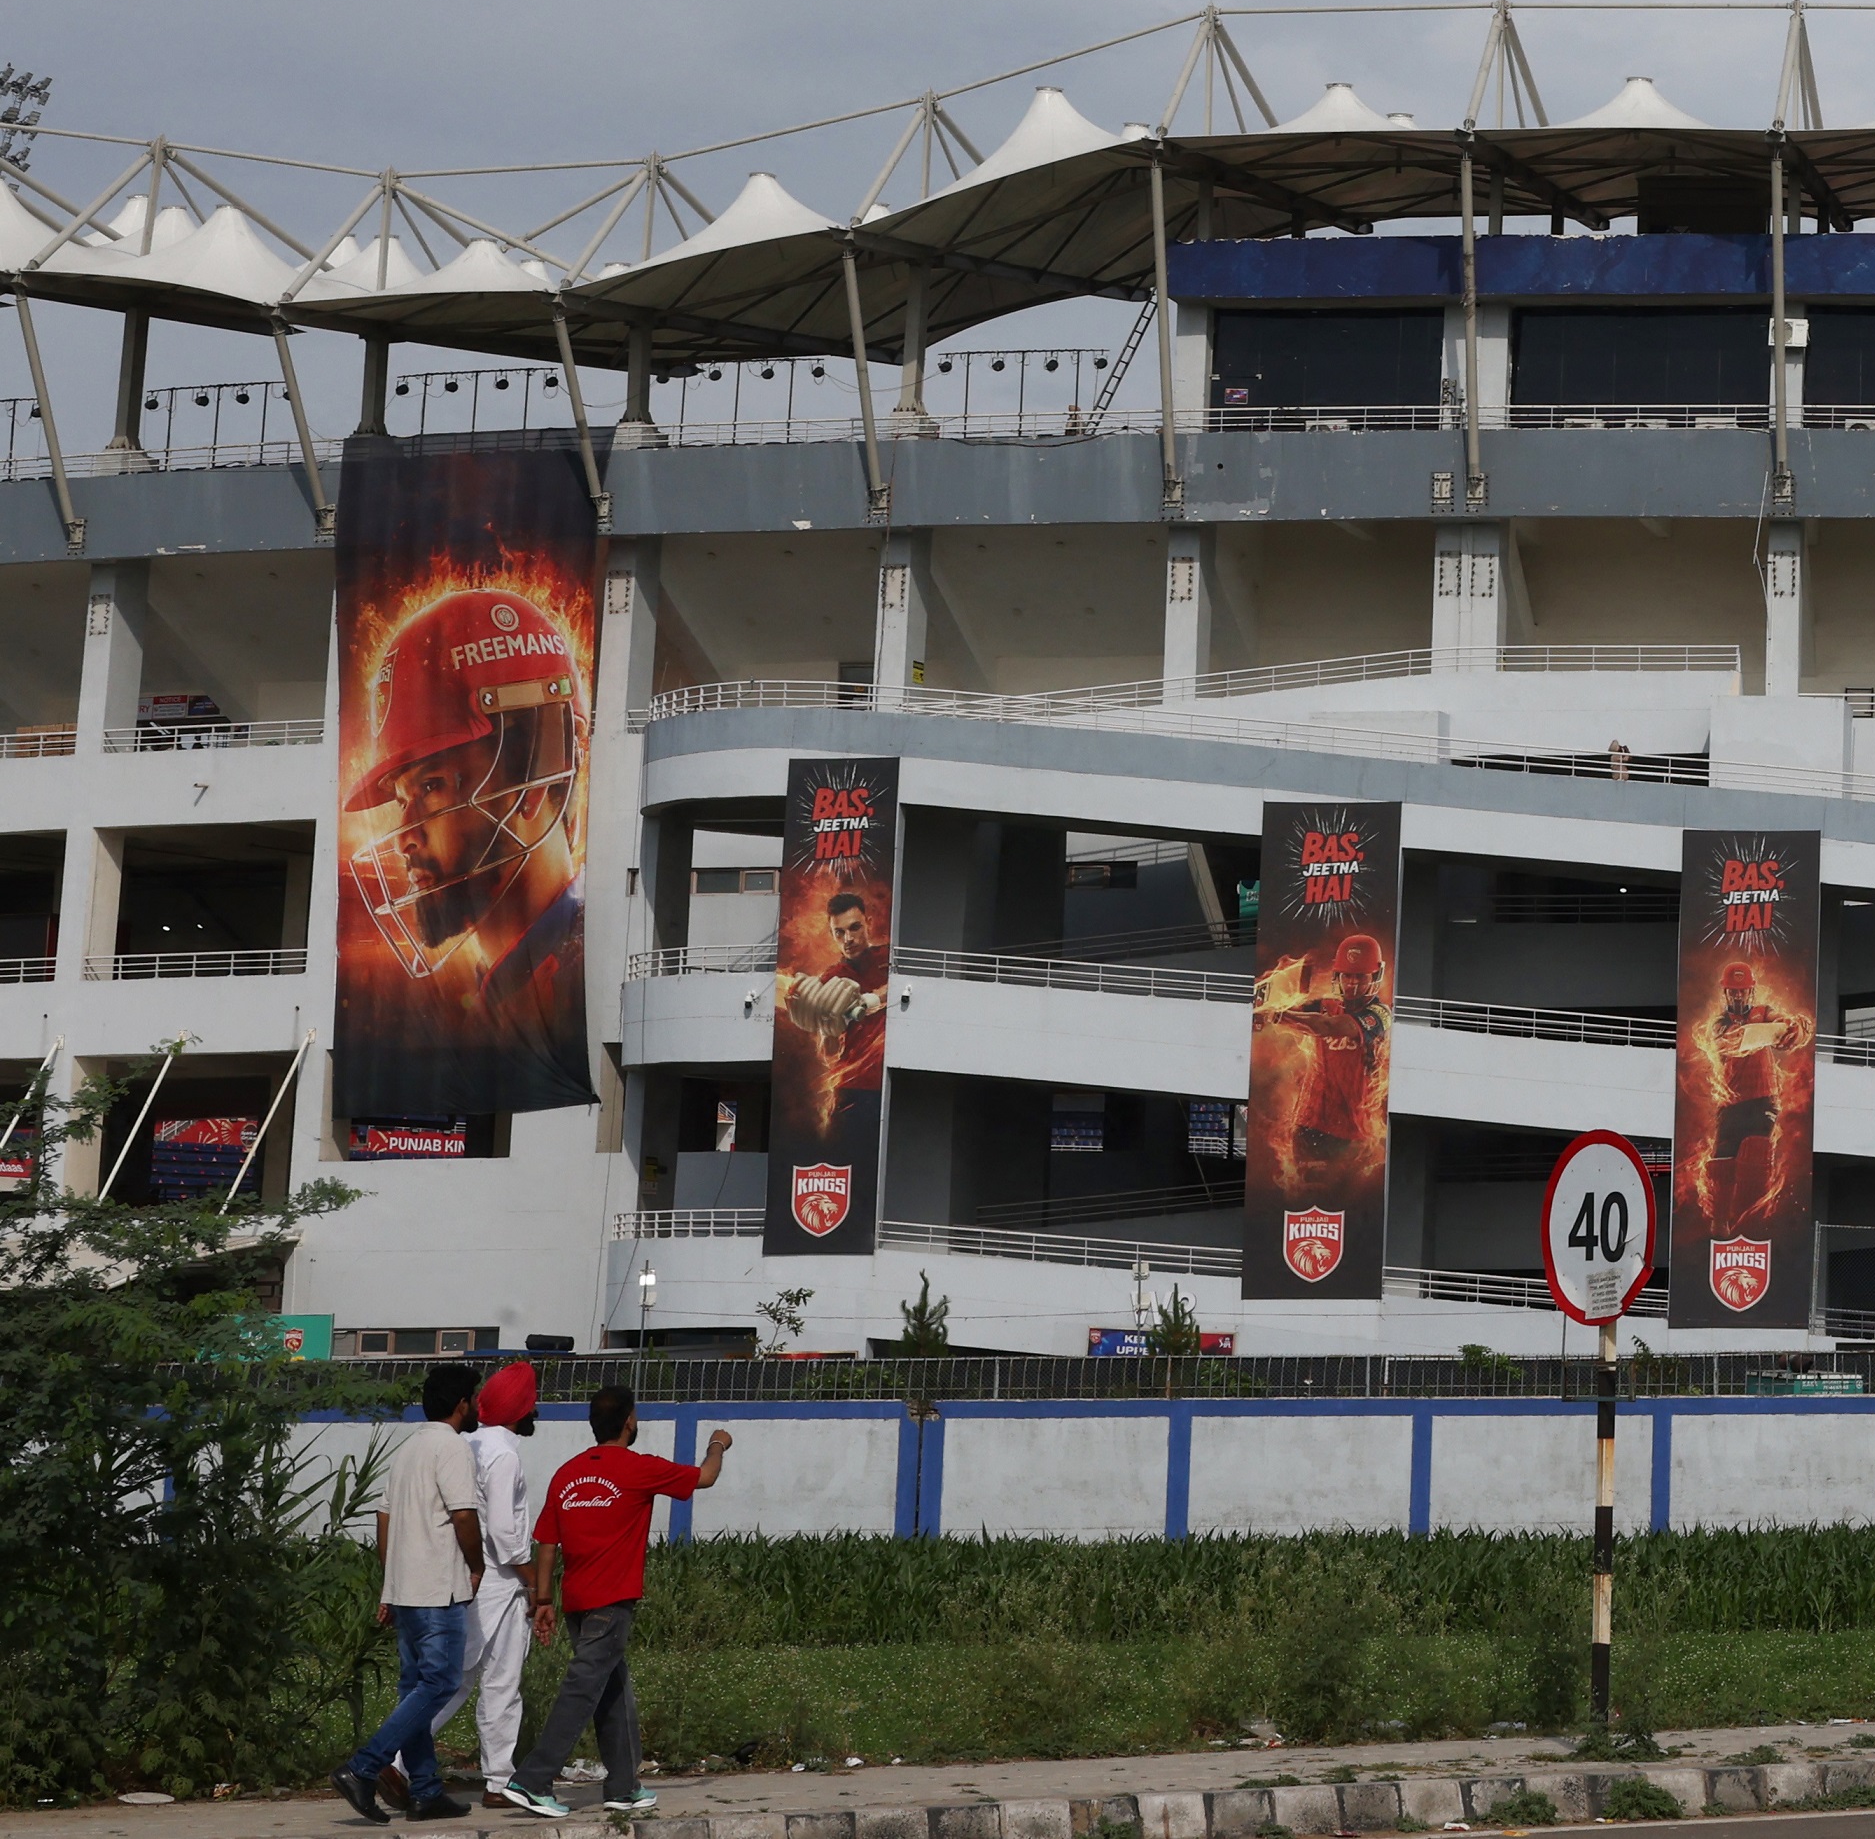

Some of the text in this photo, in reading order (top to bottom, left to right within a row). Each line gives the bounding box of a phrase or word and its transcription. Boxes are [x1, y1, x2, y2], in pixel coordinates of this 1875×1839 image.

[450, 632, 566, 671] FREEMANS
[811, 787, 875, 821] BAS,
[812, 816, 870, 833] JEETNA
[814, 830, 863, 860] HAI
[1301, 831, 1365, 866] BAS,
[1302, 860, 1360, 877] JEETNA
[1721, 859, 1785, 894] BAS,
[1304, 874, 1353, 904] HAI
[1722, 888, 1780, 905] JEETNA
[1725, 902, 1773, 933] HAI
[388, 1137, 441, 1152] PUNJAB
[0, 1161, 24, 1173] daas
[797, 1177, 847, 1196] KINGS
[1288, 1223, 1340, 1241] KINGS
[1568, 1191, 1629, 1263] 40
[1715, 1252, 1766, 1271] KINGS
[559, 1476, 623, 1500] MAJOR LEAGUE BASEBALL
[562, 1492, 616, 1511] Essentials
